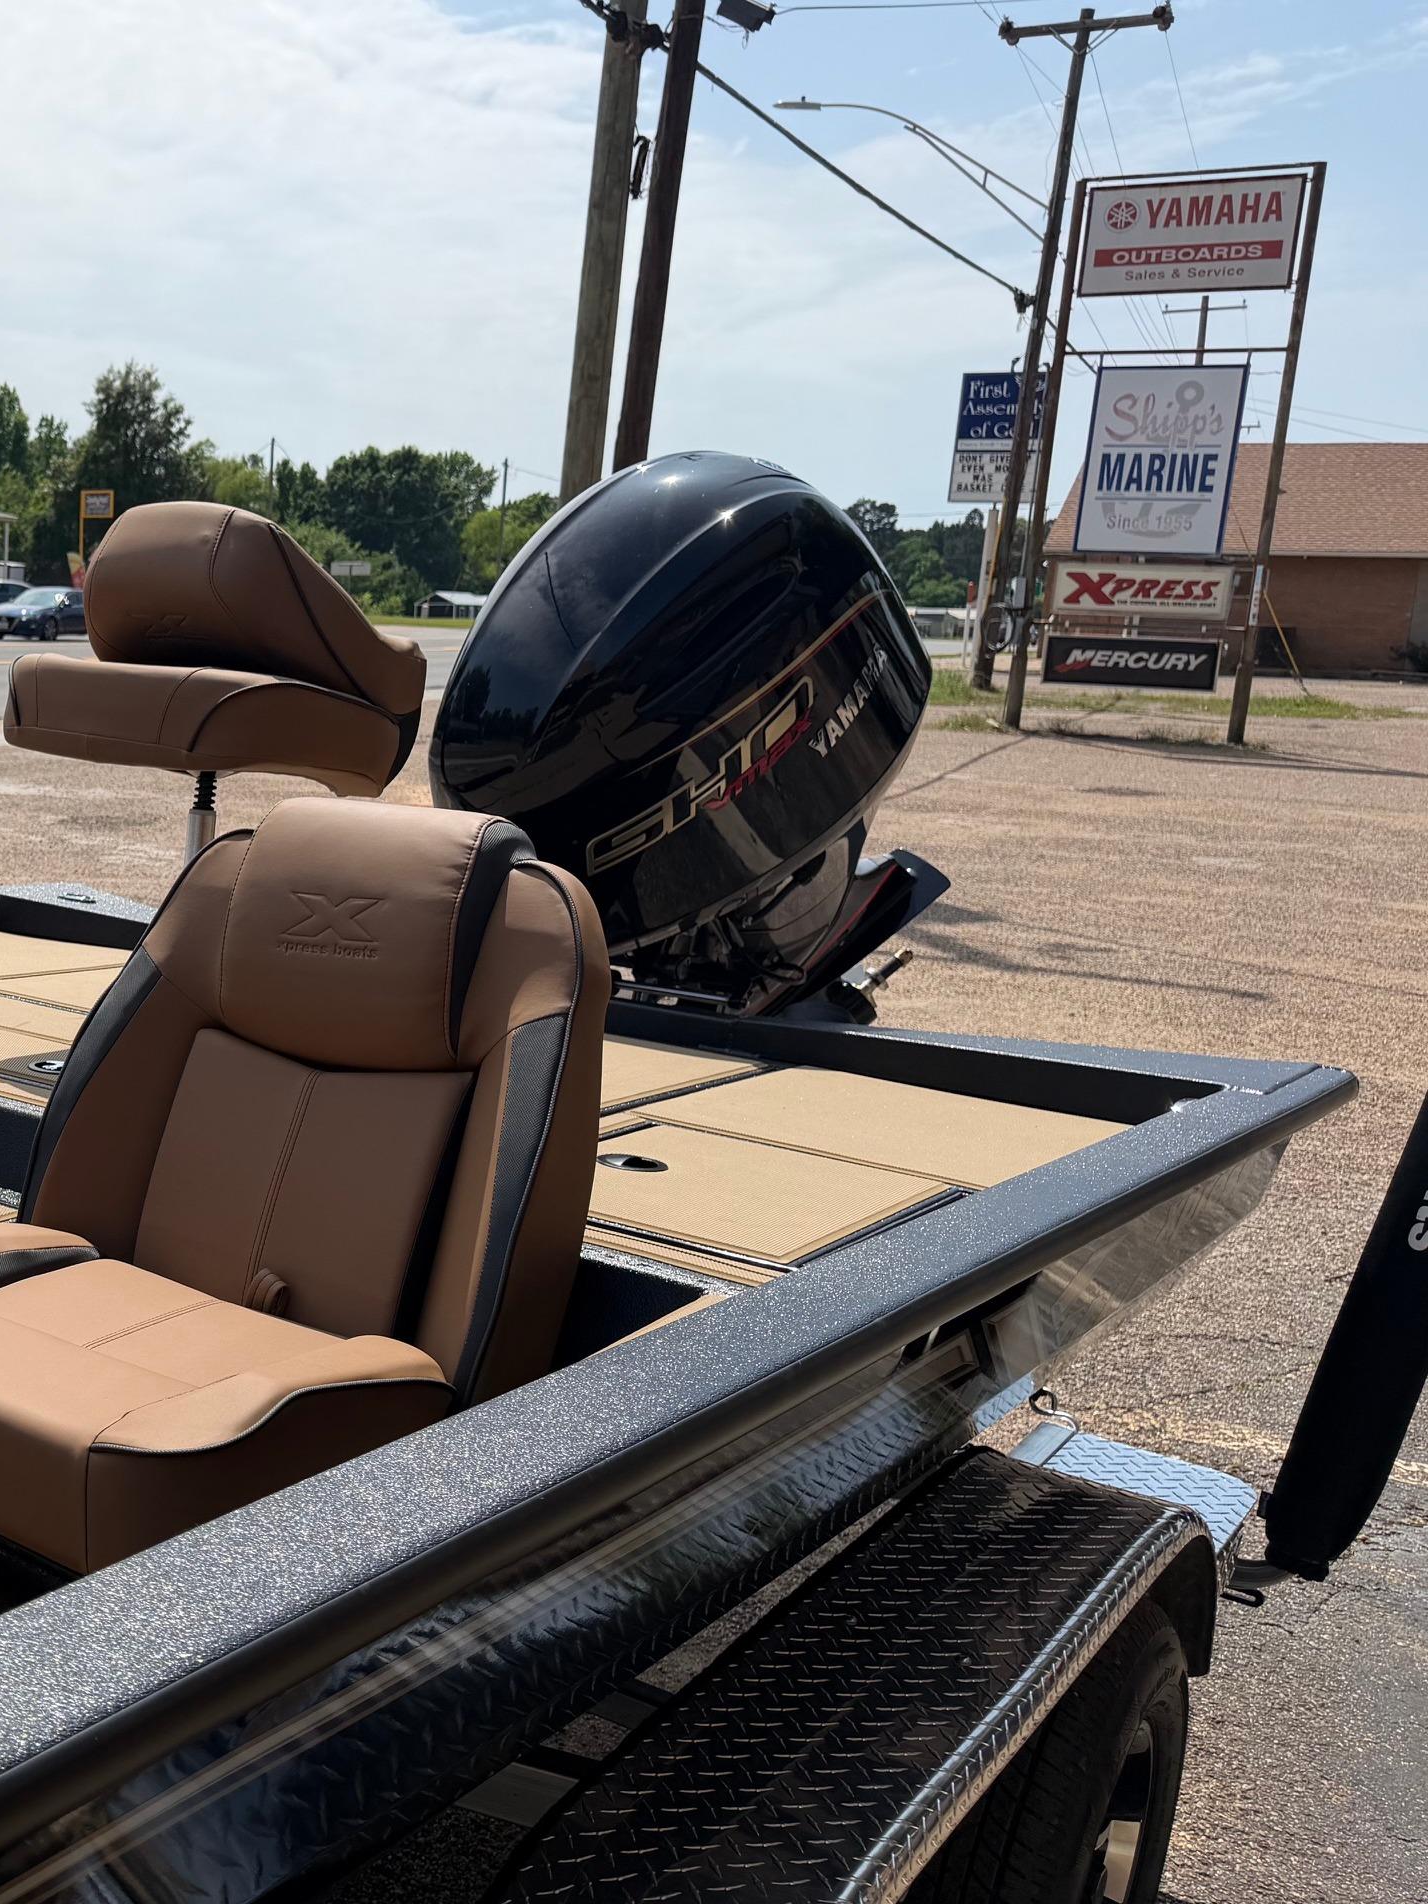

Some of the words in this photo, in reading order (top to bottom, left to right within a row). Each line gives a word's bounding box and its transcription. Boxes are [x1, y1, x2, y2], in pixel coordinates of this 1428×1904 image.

[1145, 191, 1283, 229] YAMAHA
[1112, 244, 1263, 265] OUTBOARDS
[1124, 269, 1166, 281] Sales
[1171, 269, 1180, 279] &
[1187, 266, 1245, 278] Service
[969, 379, 1011, 399] First
[970, 421, 992, 438] of
[1105, 392, 1224, 450] Shipp's
[961, 464, 985, 473] EVEN
[972, 474, 993, 483] WAS
[1097, 453, 1219, 493] MARINE
[956, 483, 993, 493] BASKET
[1106, 514, 1150, 530] Since
[1155, 515, 1193, 531] 1955
[1063, 572, 1220, 605] XPRESS
[1064, 648, 1208, 672] MERCURY
[808, 642, 888, 758] YAMAHA
[332, 943, 379, 959] boats
